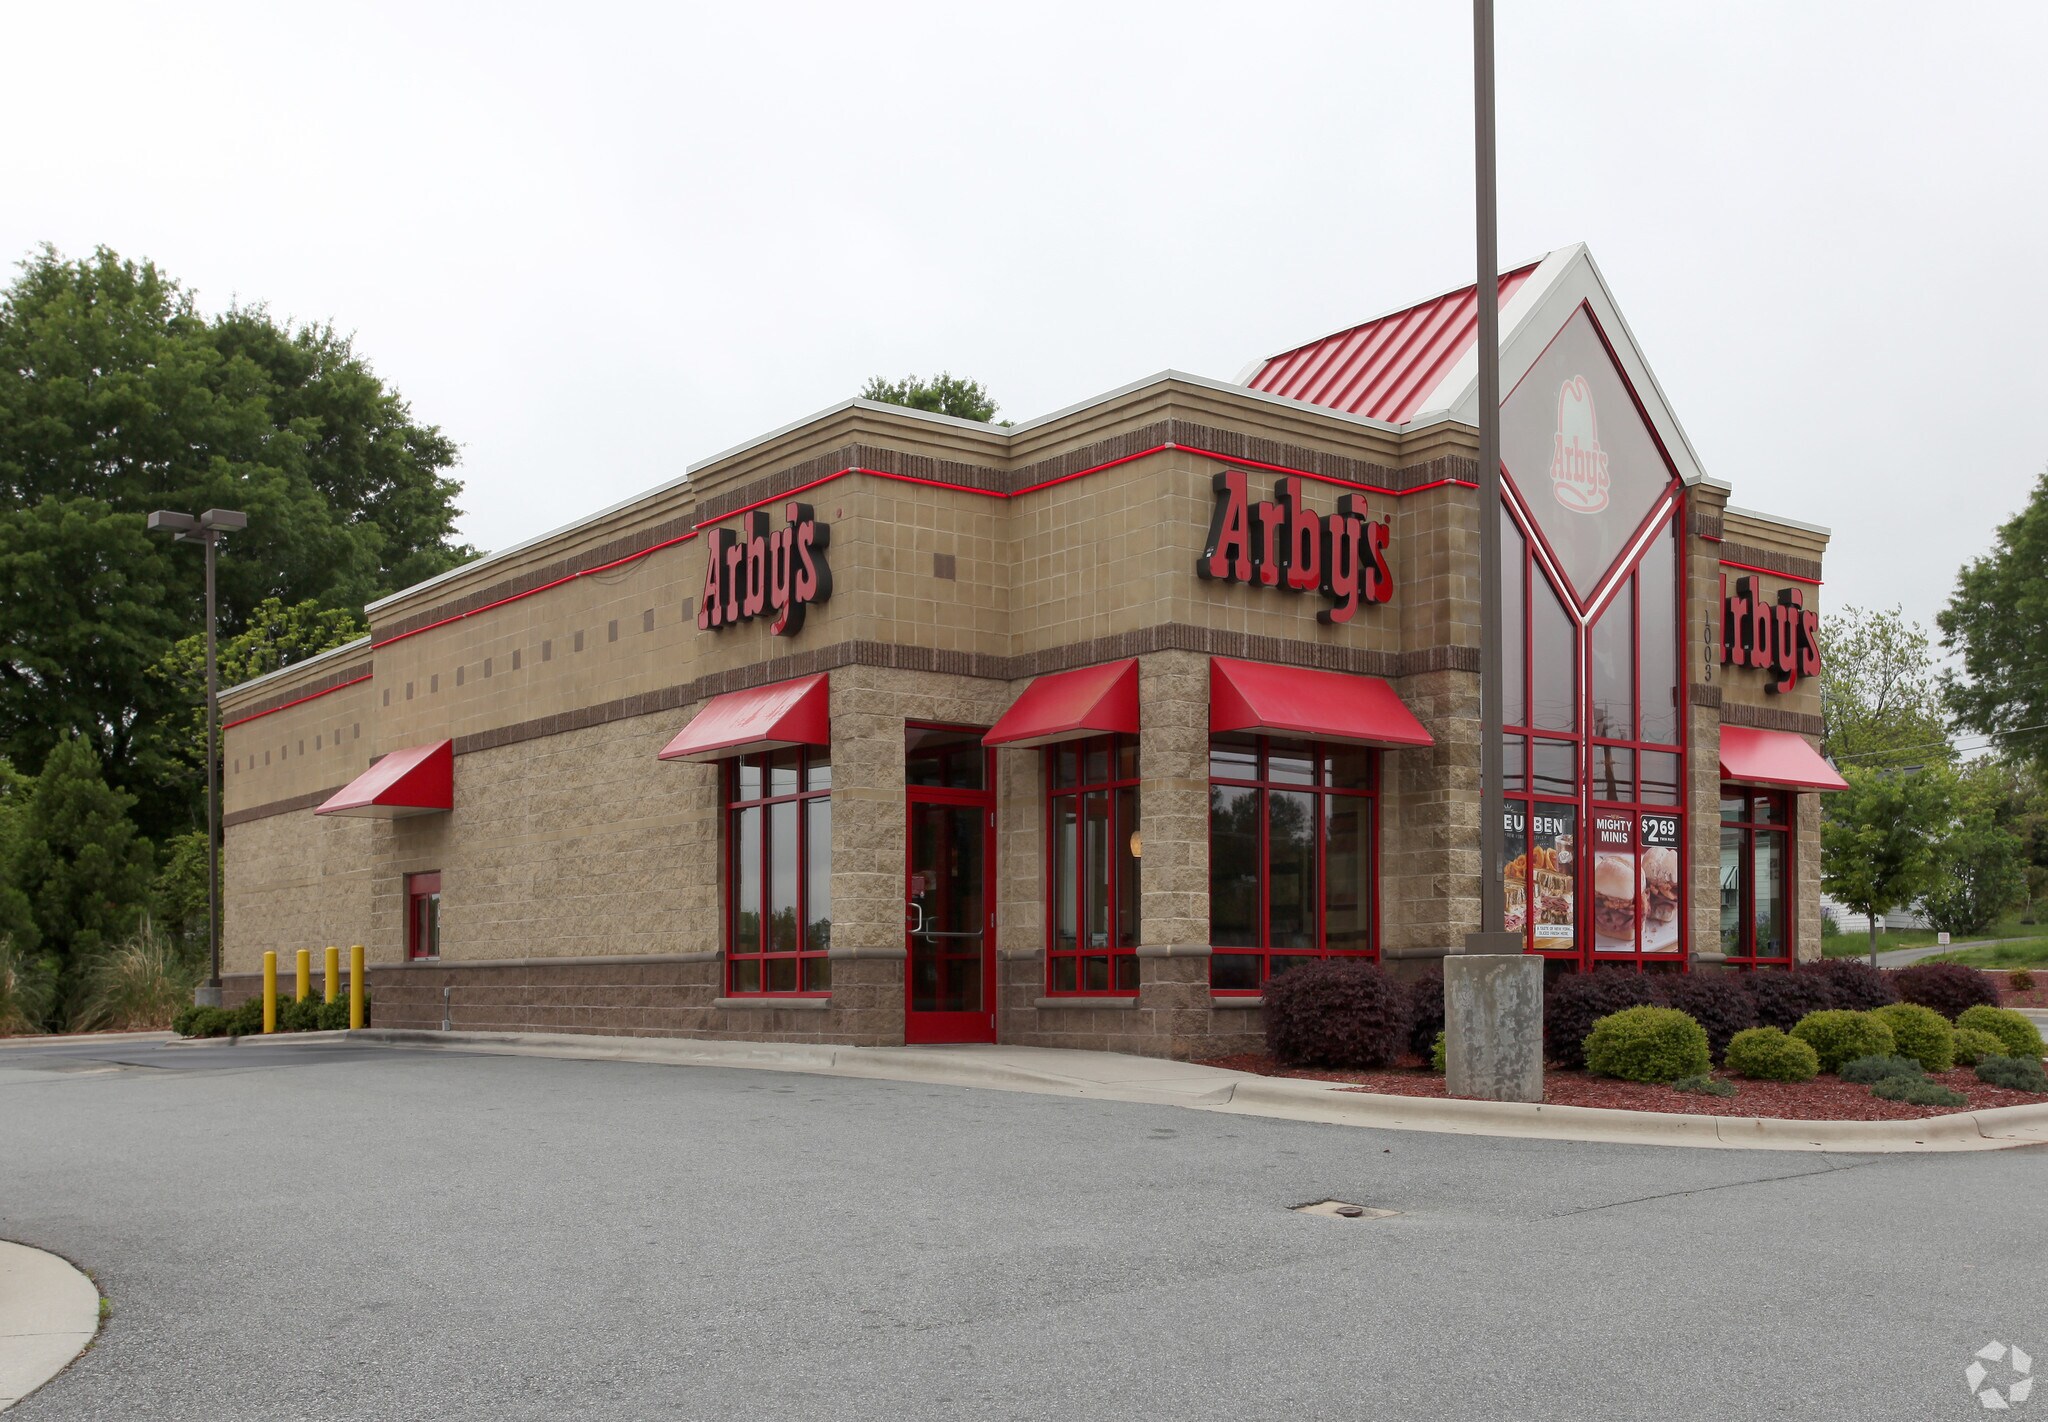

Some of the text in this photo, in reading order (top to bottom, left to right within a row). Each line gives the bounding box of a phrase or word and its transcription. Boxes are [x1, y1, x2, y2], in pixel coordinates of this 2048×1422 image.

[1550, 433, 1610, 496] Arby's
[698, 501, 826, 636] Arby's
[1202, 470, 1394, 624] Arby's
[1596, 818, 1632, 832] MIGHTY
[1601, 831, 1628, 844] MINIS
